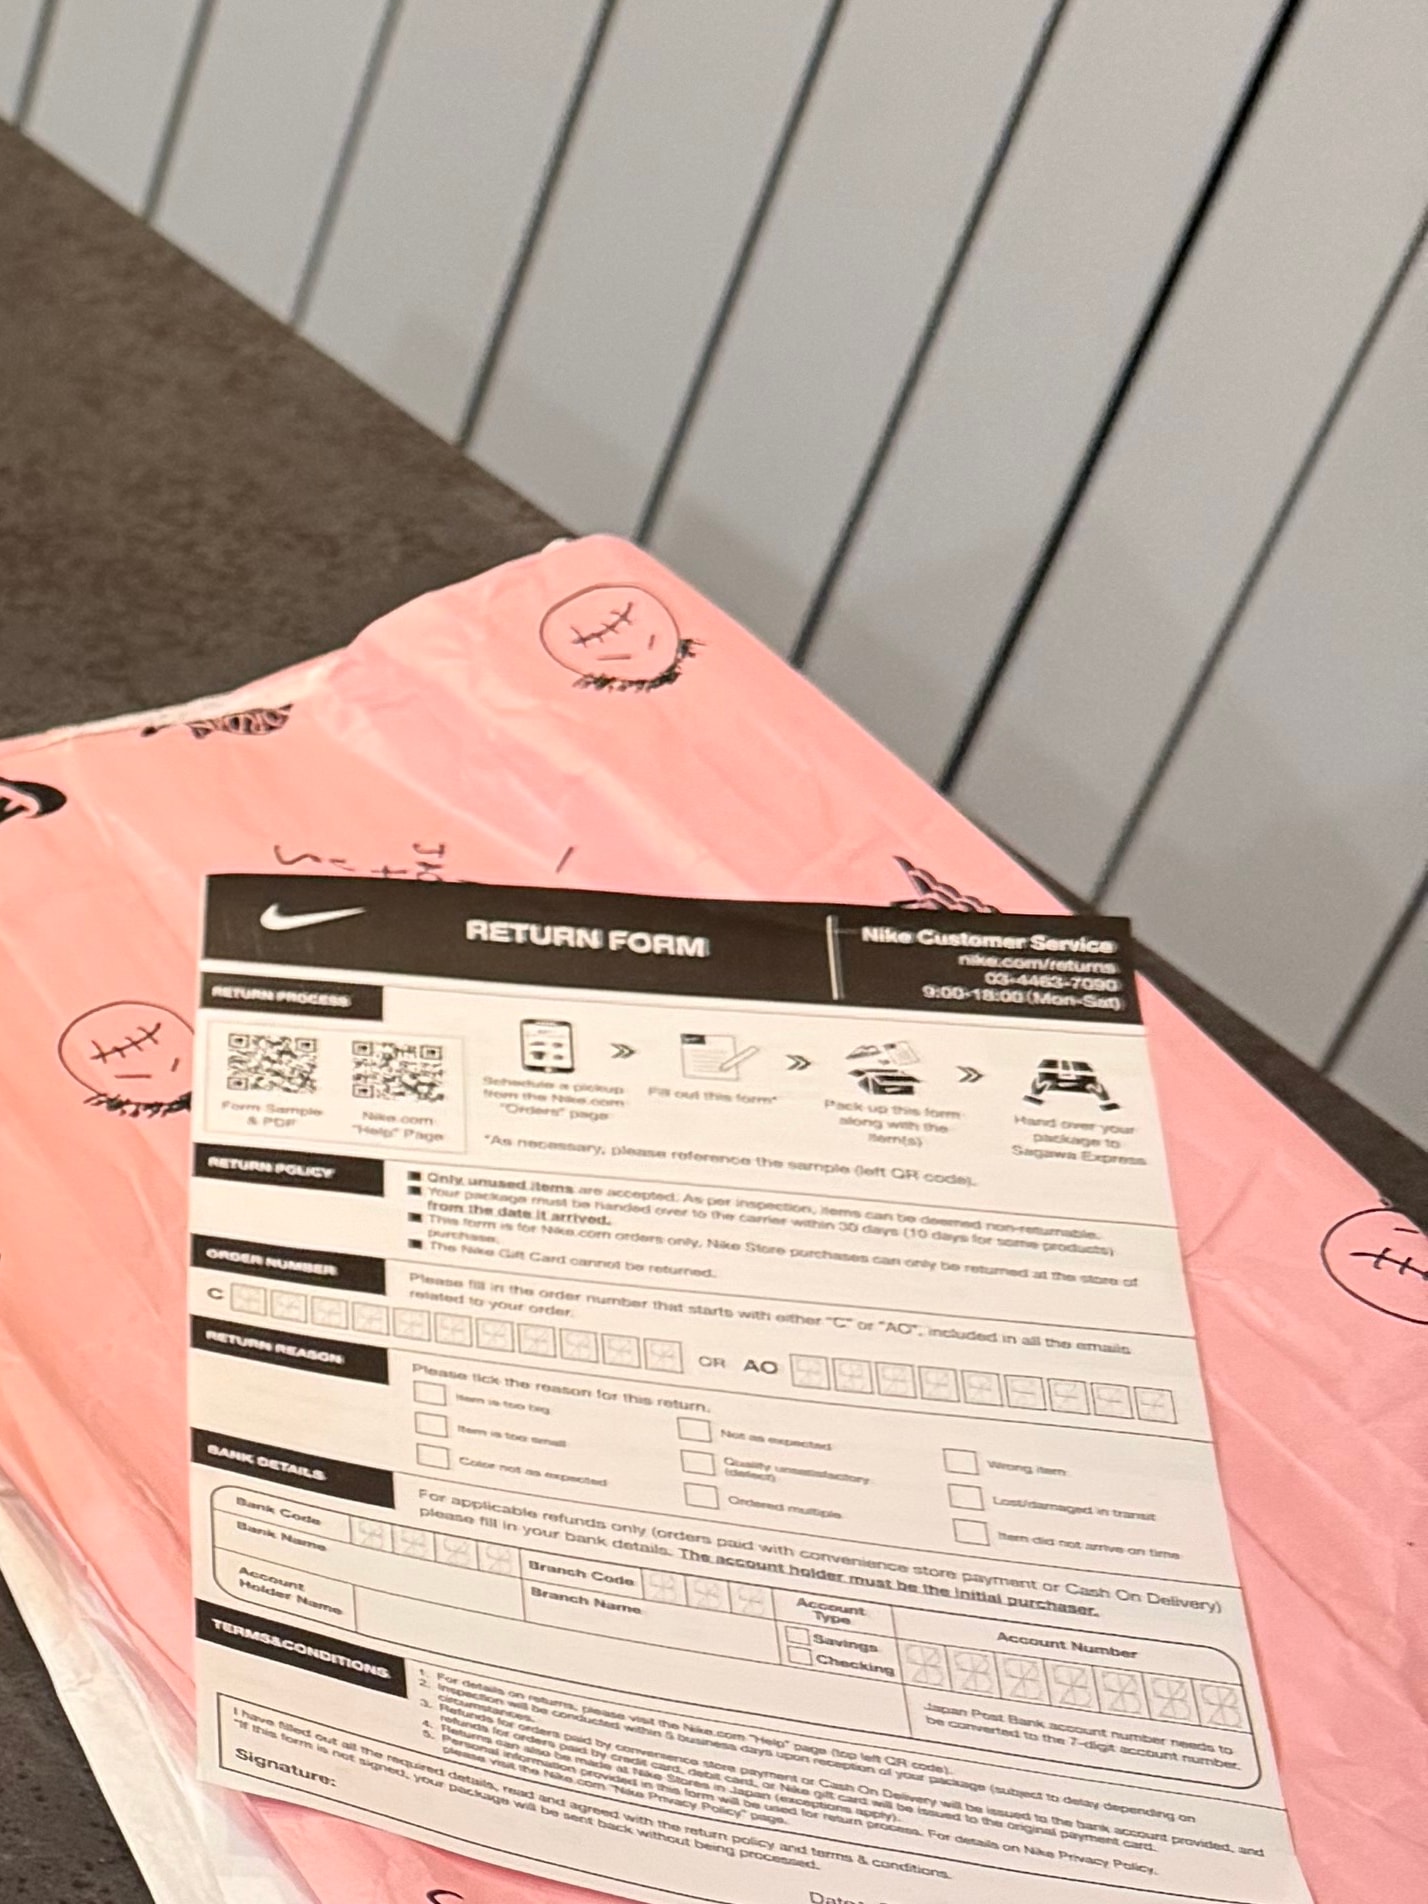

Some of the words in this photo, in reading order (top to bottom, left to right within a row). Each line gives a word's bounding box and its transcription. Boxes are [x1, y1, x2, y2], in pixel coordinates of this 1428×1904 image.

[466, 919, 602, 951] RETURN
[608, 929, 708, 958] FORM
[862, 926, 912, 944] Nike
[916, 928, 1026, 949] Customer
[1030, 934, 1113, 953] Service
[958, 954, 1116, 973] nike.com/returns
[211, 986, 275, 1002] RETURN
[275, 990, 350, 1007] PROCESS
[207, 1158, 274, 1175] RETURN
[273, 1163, 334, 1180] POLICY
[611, 1145, 666, 1158] please
[671, 1150, 751, 1165] reference
[755, 1156, 783, 1168] the
[787, 1161, 850, 1175] sample
[890, 1167, 918, 1180] QR
[205, 1248, 263, 1266] ORDER
[264, 1255, 336, 1275] NUMBER
[206, 1287, 223, 1300] C
[205, 1330, 272, 1353] RETURN
[274, 1341, 344, 1365] REASON
[698, 1356, 726, 1369] OR
[743, 1359, 778, 1375] AO
[412, 1362, 467, 1380] Please
[472, 1370, 499, 1384] tick
[504, 1375, 530, 1388] the
[535, 1382, 591, 1396] reason
[596, 1387, 617, 1399] for
[622, 1390, 652, 1403] this
[207, 1444, 254, 1466] BANK
[256, 1454, 326, 1481] DETAILS
[235, 1496, 274, 1515] Bank
[279, 1506, 321, 1525] Code
[236, 1520, 276, 1539] Bank
[280, 1530, 326, 1551] Name
[418, 1488, 445, 1502] For
[451, 1496, 537, 1518] applicable
[542, 1511, 606, 1529] refunds
[611, 1522, 646, 1538] only
[716, 1538, 754, 1551] paid
[758, 1543, 794, 1557] with
[799, 1550, 908, 1572] convenience
[912, 1564, 956, 1579] store
[961, 1572, 1037, 1589] payment
[1042, 1582, 1060, 1591] or
[1064, 1582, 1110, 1597] Cash
[1114, 1587, 1141, 1601] On
[419, 1509, 474, 1526] please
[479, 1516, 497, 1529] fill
[502, 1520, 517, 1532] in
[522, 1525, 559, 1538] your
[564, 1528, 606, 1545] bank
[680, 1545, 710, 1560] The
[715, 1553, 784, 1571] account
[788, 1561, 843, 1579] holder
[848, 1572, 891, 1586] must
[896, 1576, 918, 1590] be
[922, 1580, 950, 1594] the
[954, 1584, 1002, 1601] initial
[238, 1565, 304, 1591] Account
[528, 1559, 586, 1579] Branch
[590, 1570, 634, 1587] Code
[239, 1578, 291, 1601] Holder
[296, 1592, 342, 1614] Name
[530, 1586, 589, 1605] Branch
[593, 1596, 641, 1614] Name
[796, 1598, 866, 1616] Account
[815, 1610, 851, 1627] Type
[211, 1618, 390, 1681] TERMS&CONDITIONS
[812, 1631, 878, 1654] Savings
[997, 1631, 1066, 1649] Account
[1070, 1639, 1137, 1658] Number
[815, 1652, 894, 1677] Checking
[924, 1702, 967, 1717] Japan
[970, 1708, 1003, 1722] Post
[1007, 1714, 1045, 1728] Bank
[1048, 1722, 1106, 1737] account
[1110, 1731, 1165, 1745] number
[1170, 1739, 1215, 1752] needs
[1218, 1743, 1233, 1755] to
[925, 1716, 944, 1728] be
[947, 1721, 1020, 1738] converted
[1023, 1729, 1038, 1741] to
[1041, 1732, 1065, 1745] the
[1070, 1736, 1115, 1753] 7-digit
[1119, 1746, 1178, 1761] account
[235, 1745, 336, 1786] Signature:
